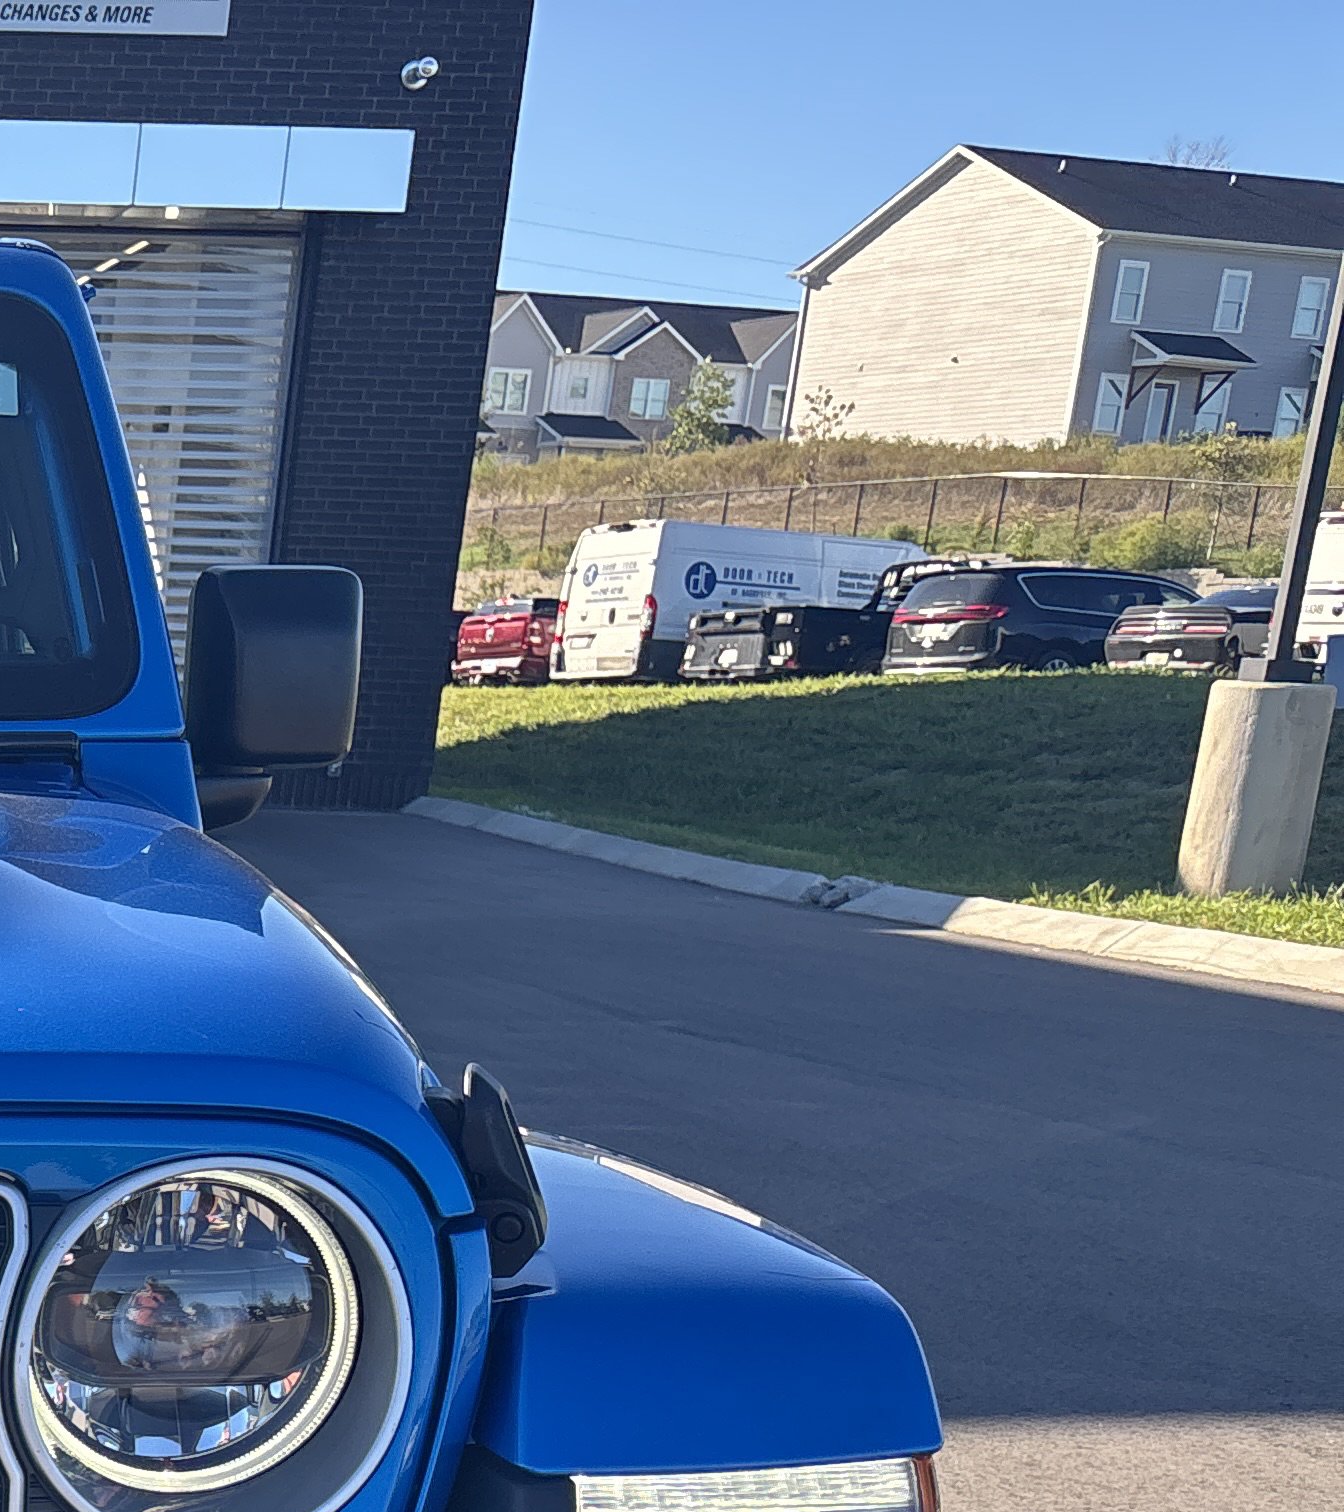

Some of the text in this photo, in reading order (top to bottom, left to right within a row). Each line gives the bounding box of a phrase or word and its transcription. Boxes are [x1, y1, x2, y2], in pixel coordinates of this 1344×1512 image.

[0, 3, 82, 22] CHANGES
[84, 5, 98, 22] &
[100, 6, 154, 24] MORE
[723, 567, 794, 585] DOOR TECH
